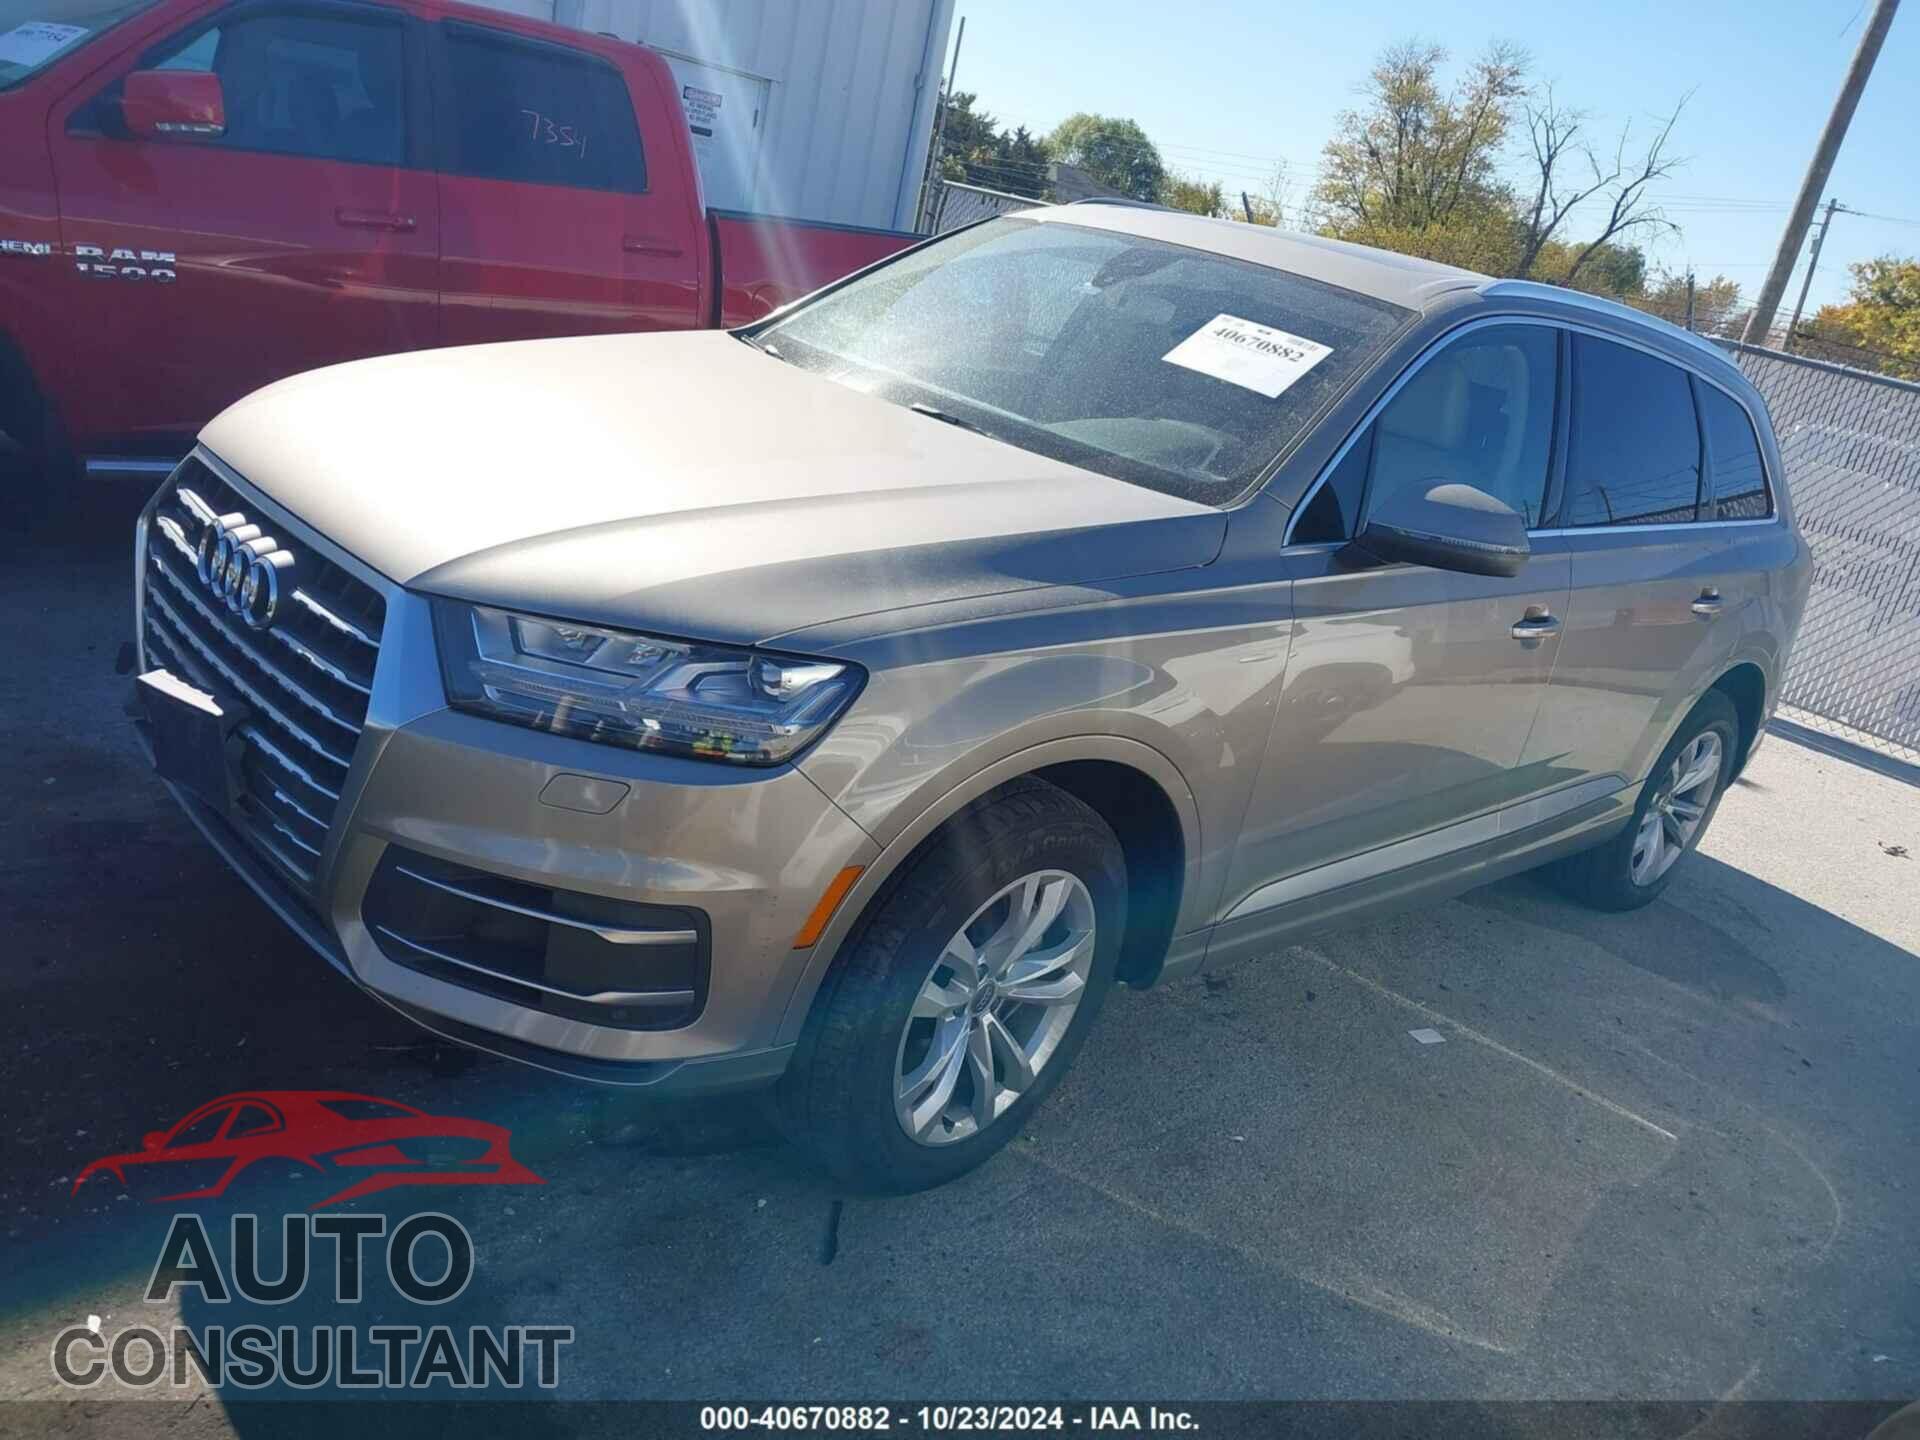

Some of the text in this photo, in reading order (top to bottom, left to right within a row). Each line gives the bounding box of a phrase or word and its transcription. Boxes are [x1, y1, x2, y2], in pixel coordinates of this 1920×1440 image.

[520, 109, 587, 159] 7354
[75, 245, 176, 265] RAM
[75, 262, 177, 283] 1500
[1213, 327, 1306, 363] 40670882
